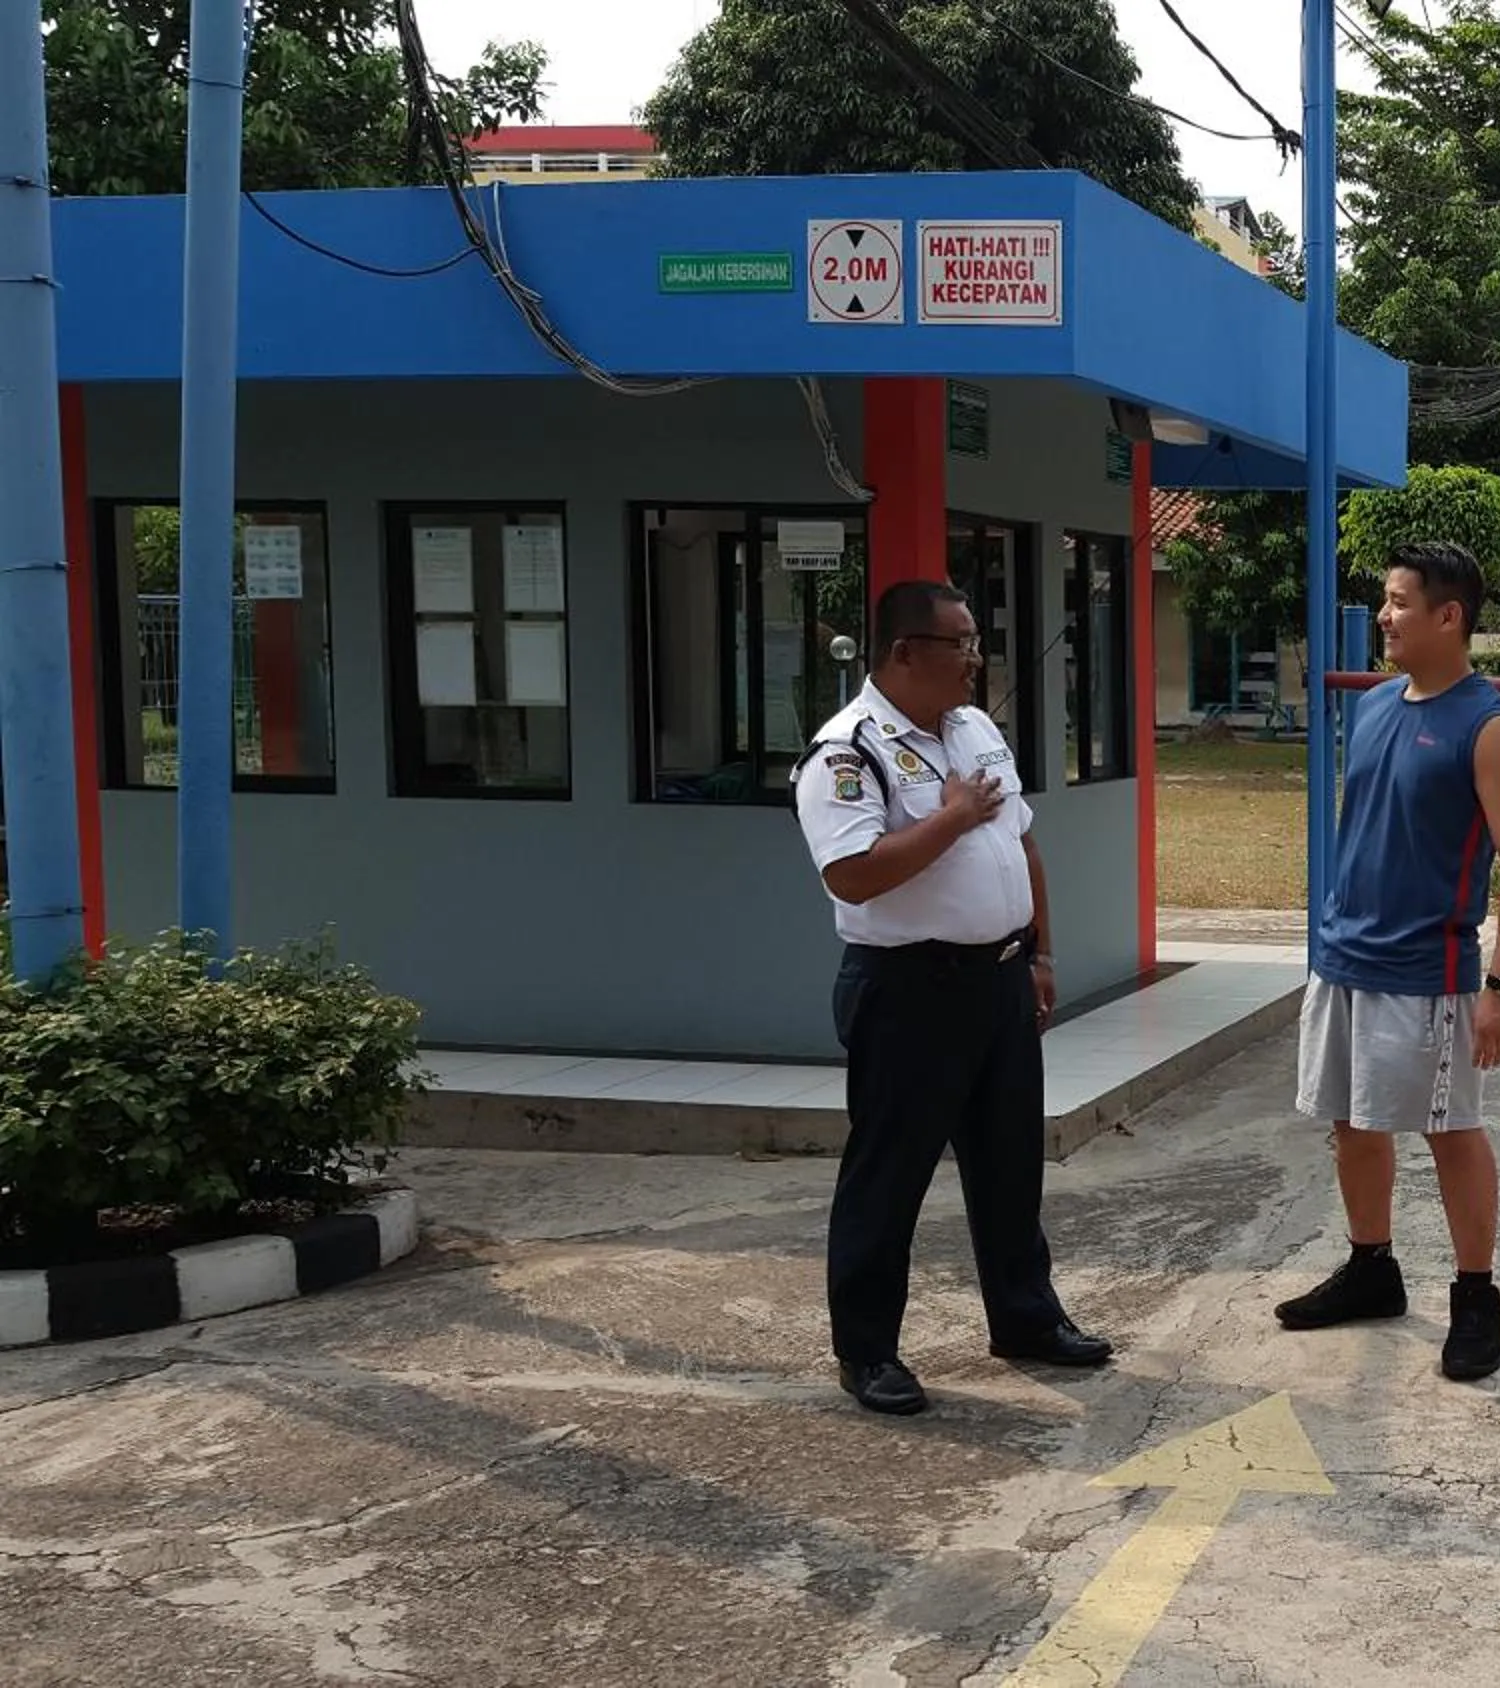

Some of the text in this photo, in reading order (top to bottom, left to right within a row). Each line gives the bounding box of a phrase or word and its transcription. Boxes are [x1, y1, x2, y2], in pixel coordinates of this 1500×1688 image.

[929, 237, 1050, 257] HATI-HATI !!!
[666, 262, 787, 282] JAGALAH KEBERSIHAN
[823, 256, 887, 284] 2,0M
[945, 260, 1035, 281] KURANGI
[932, 283, 1048, 305] KECEPATAN
